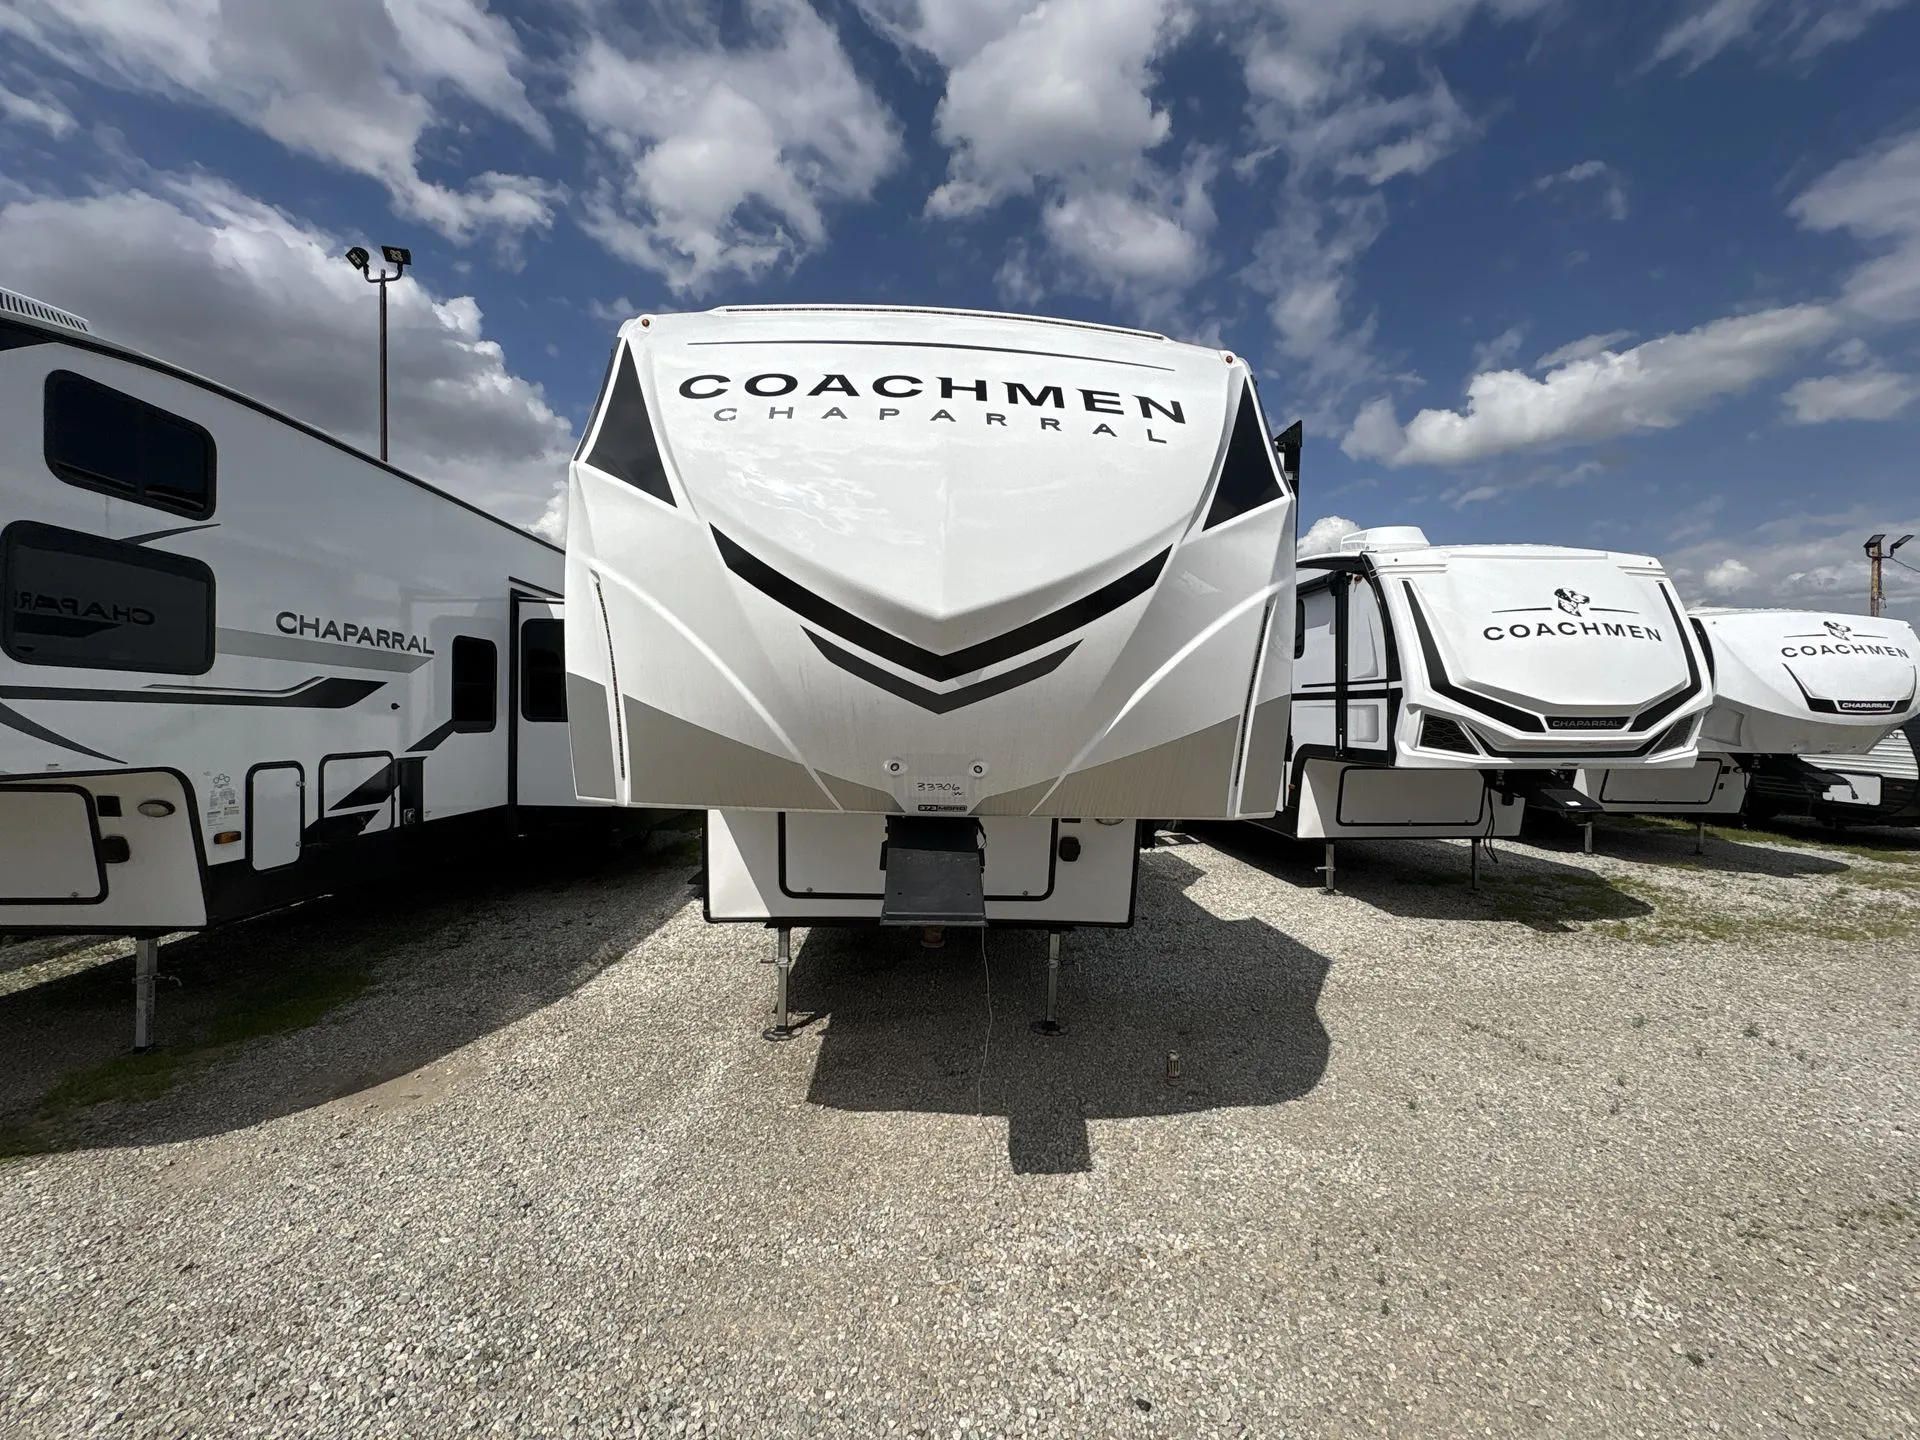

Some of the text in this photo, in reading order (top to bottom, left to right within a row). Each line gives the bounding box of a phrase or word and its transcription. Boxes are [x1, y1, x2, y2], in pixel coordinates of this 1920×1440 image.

[678, 373, 1186, 424] COACHMEN
[713, 406, 1167, 444] CHAPARRAL
[275, 611, 435, 655] CHAPARRAL
[1483, 621, 1663, 642] COACHMEN
[1781, 644, 1910, 659] COACHMEN
[1552, 719, 1621, 728] CHAPARRAL
